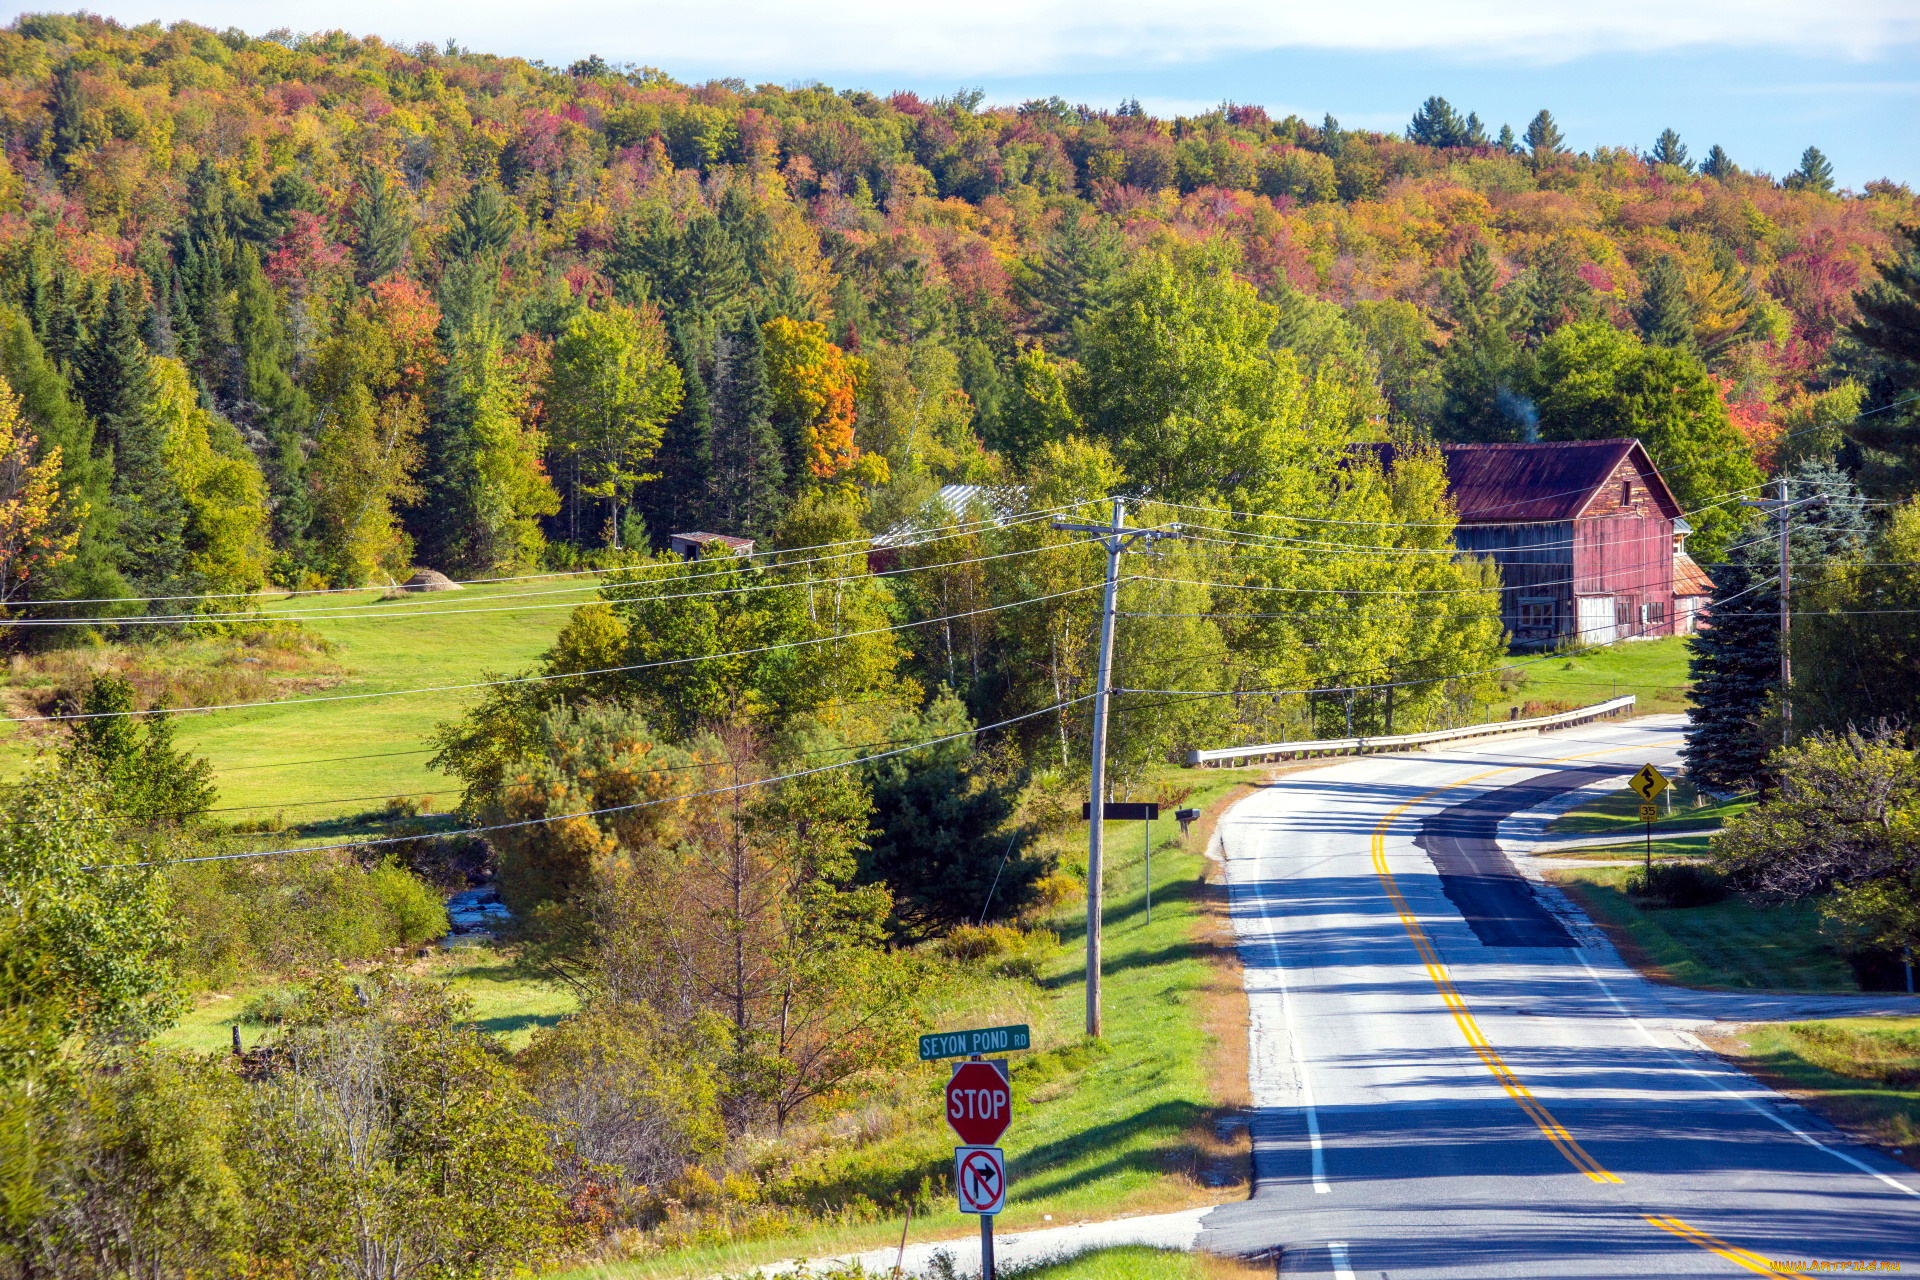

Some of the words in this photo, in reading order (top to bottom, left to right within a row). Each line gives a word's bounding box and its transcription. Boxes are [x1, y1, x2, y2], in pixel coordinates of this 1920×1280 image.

[1641, 806, 1656, 816] 35
[922, 1035, 967, 1056] SEYON
[972, 1030, 1008, 1051] POND
[1013, 1033, 1027, 1047] RD
[950, 1088, 1007, 1120] STOP
